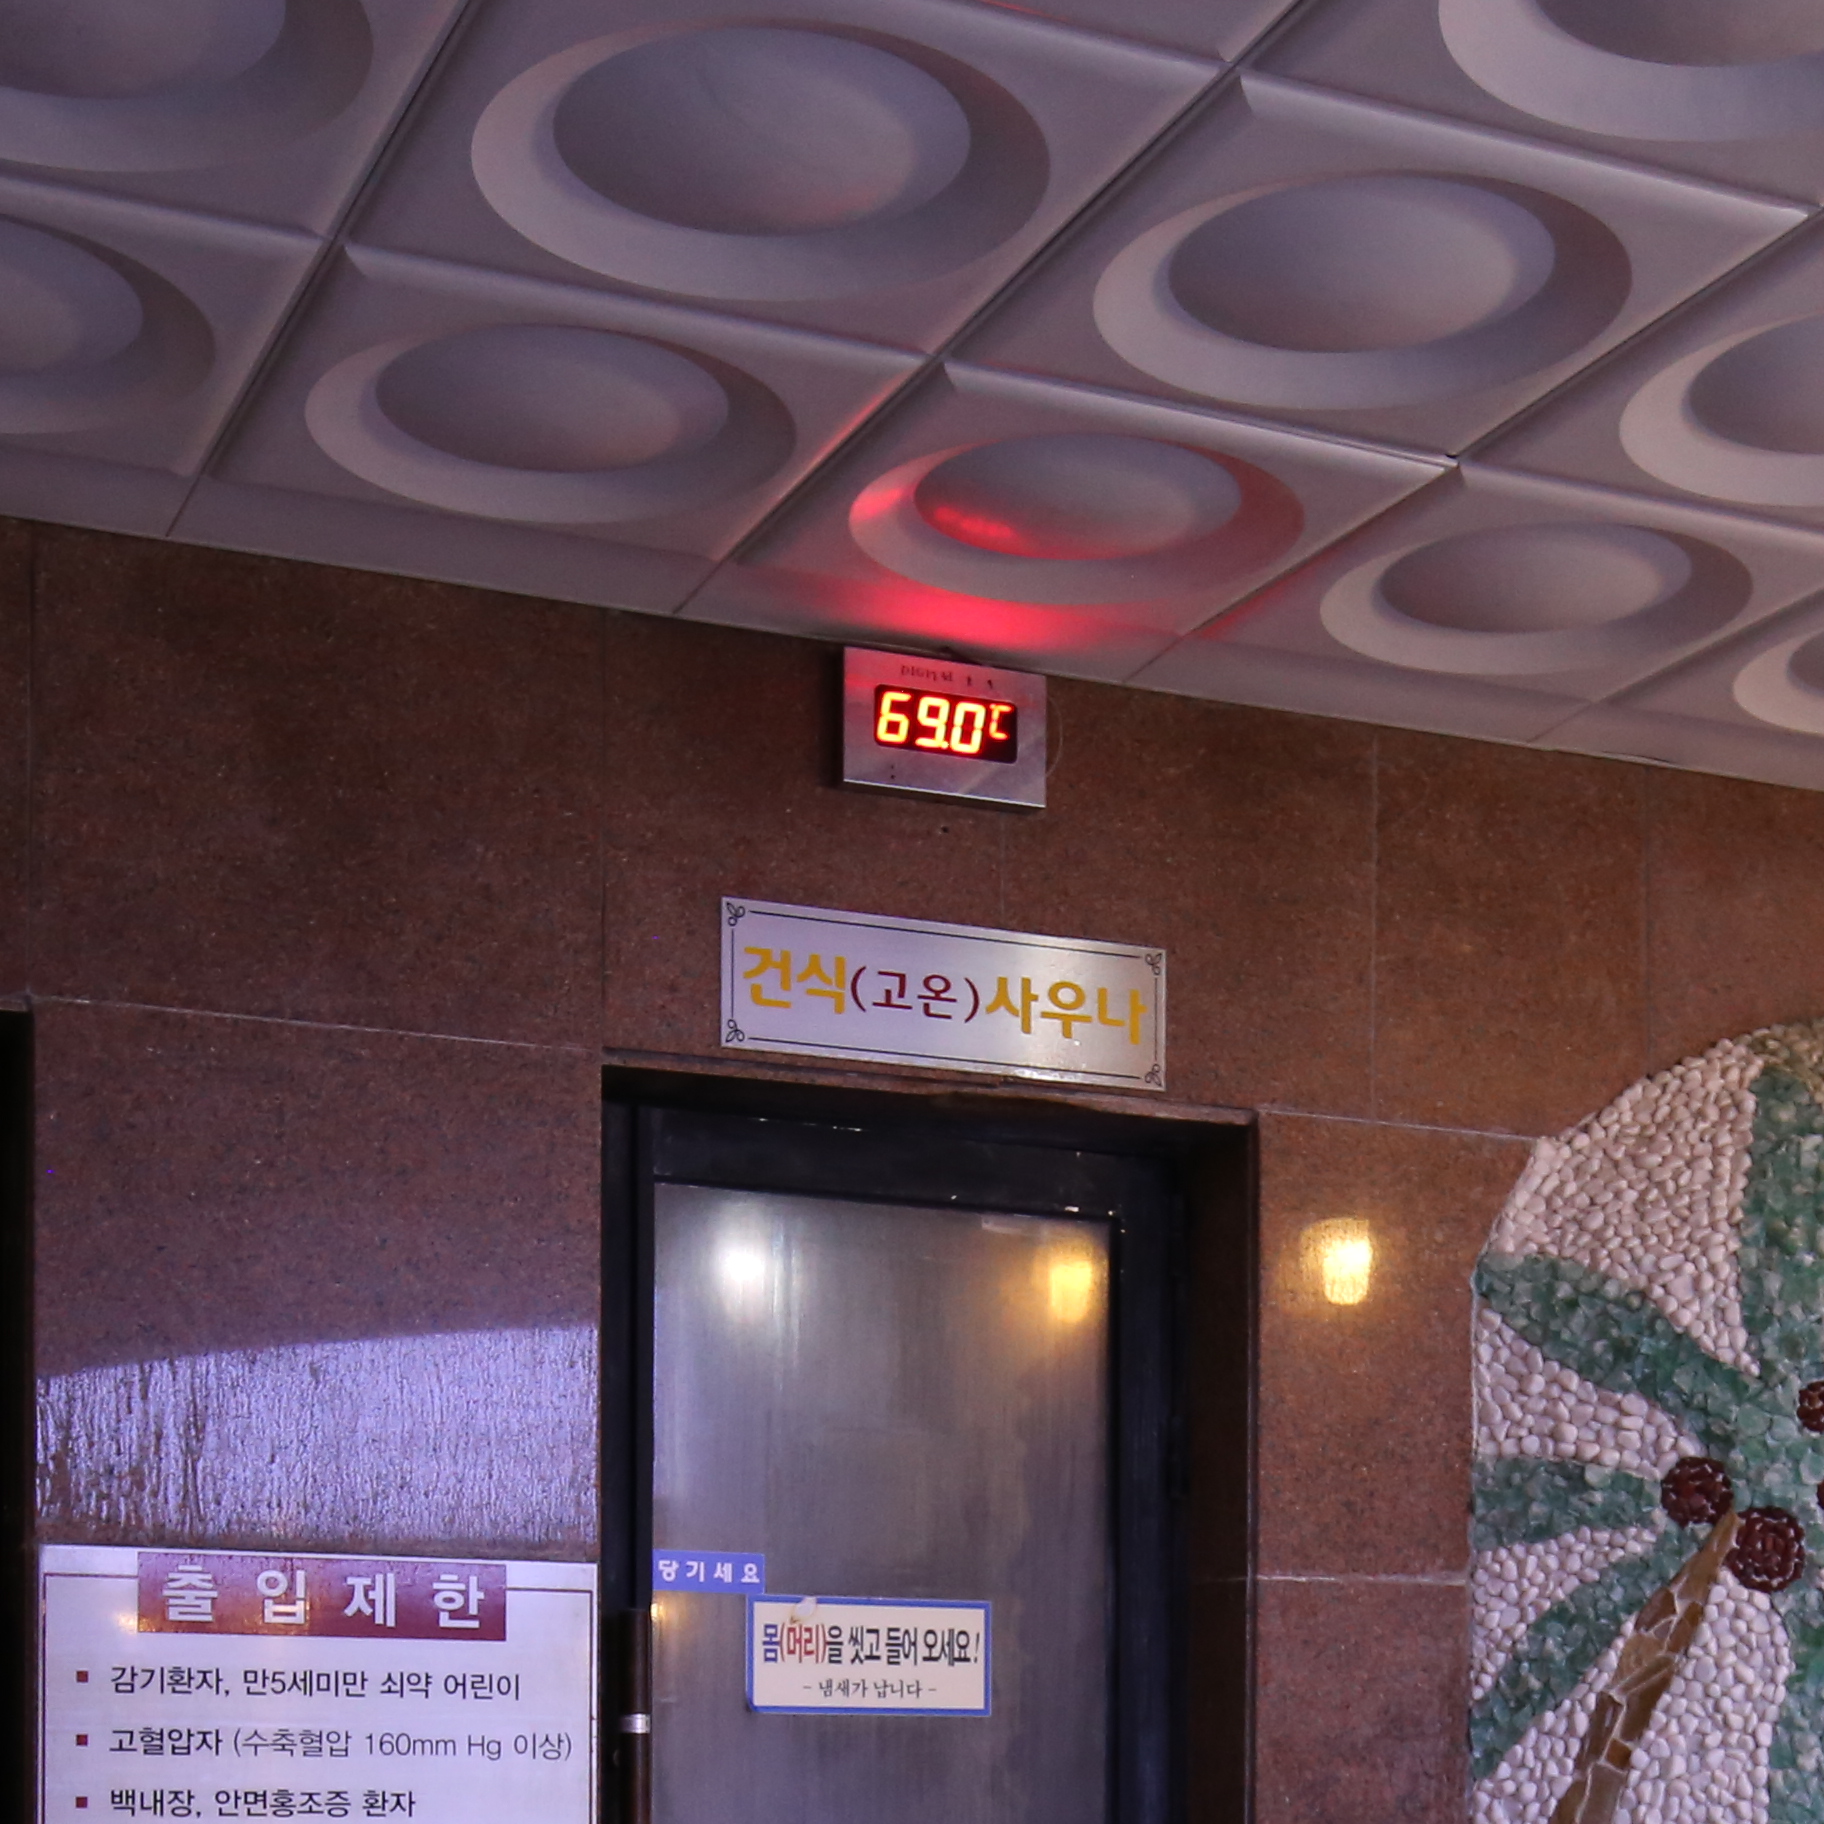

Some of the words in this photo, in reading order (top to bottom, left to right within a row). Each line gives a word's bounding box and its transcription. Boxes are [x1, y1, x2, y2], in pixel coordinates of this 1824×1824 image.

[743, 946, 1148, 1044] 건식(고온)사우나
[658, 1559, 760, 1584] 당기세요
[762, 1623, 843, 1664] 몸(머리)을
[848, 1625, 881, 1665] 씻고
[885, 1626, 918, 1666] 들어
[923, 1628, 980, 1667] 오세요!
[110, 1665, 229, 1697] 감기환자,
[243, 1669, 368, 1698] 만5세미만
[380, 1671, 433, 1699] 쇠약
[444, 1673, 520, 1700] 어린이
[819, 1679, 868, 1698] 냄새가
[874, 1679, 923, 1699] 납니다
[109, 1728, 223, 1756] 고혈압자
[233, 1728, 352, 1758] (수축혈압
[366, 1733, 456, 1757] 160mm
[468, 1735, 501, 1761] Hg
[514, 1732, 572, 1761] 이상)
[110, 1789, 201, 1818] 백내장,
[215, 1789, 351, 1818] 안면홍조증
[362, 1789, 416, 1818] 환자
